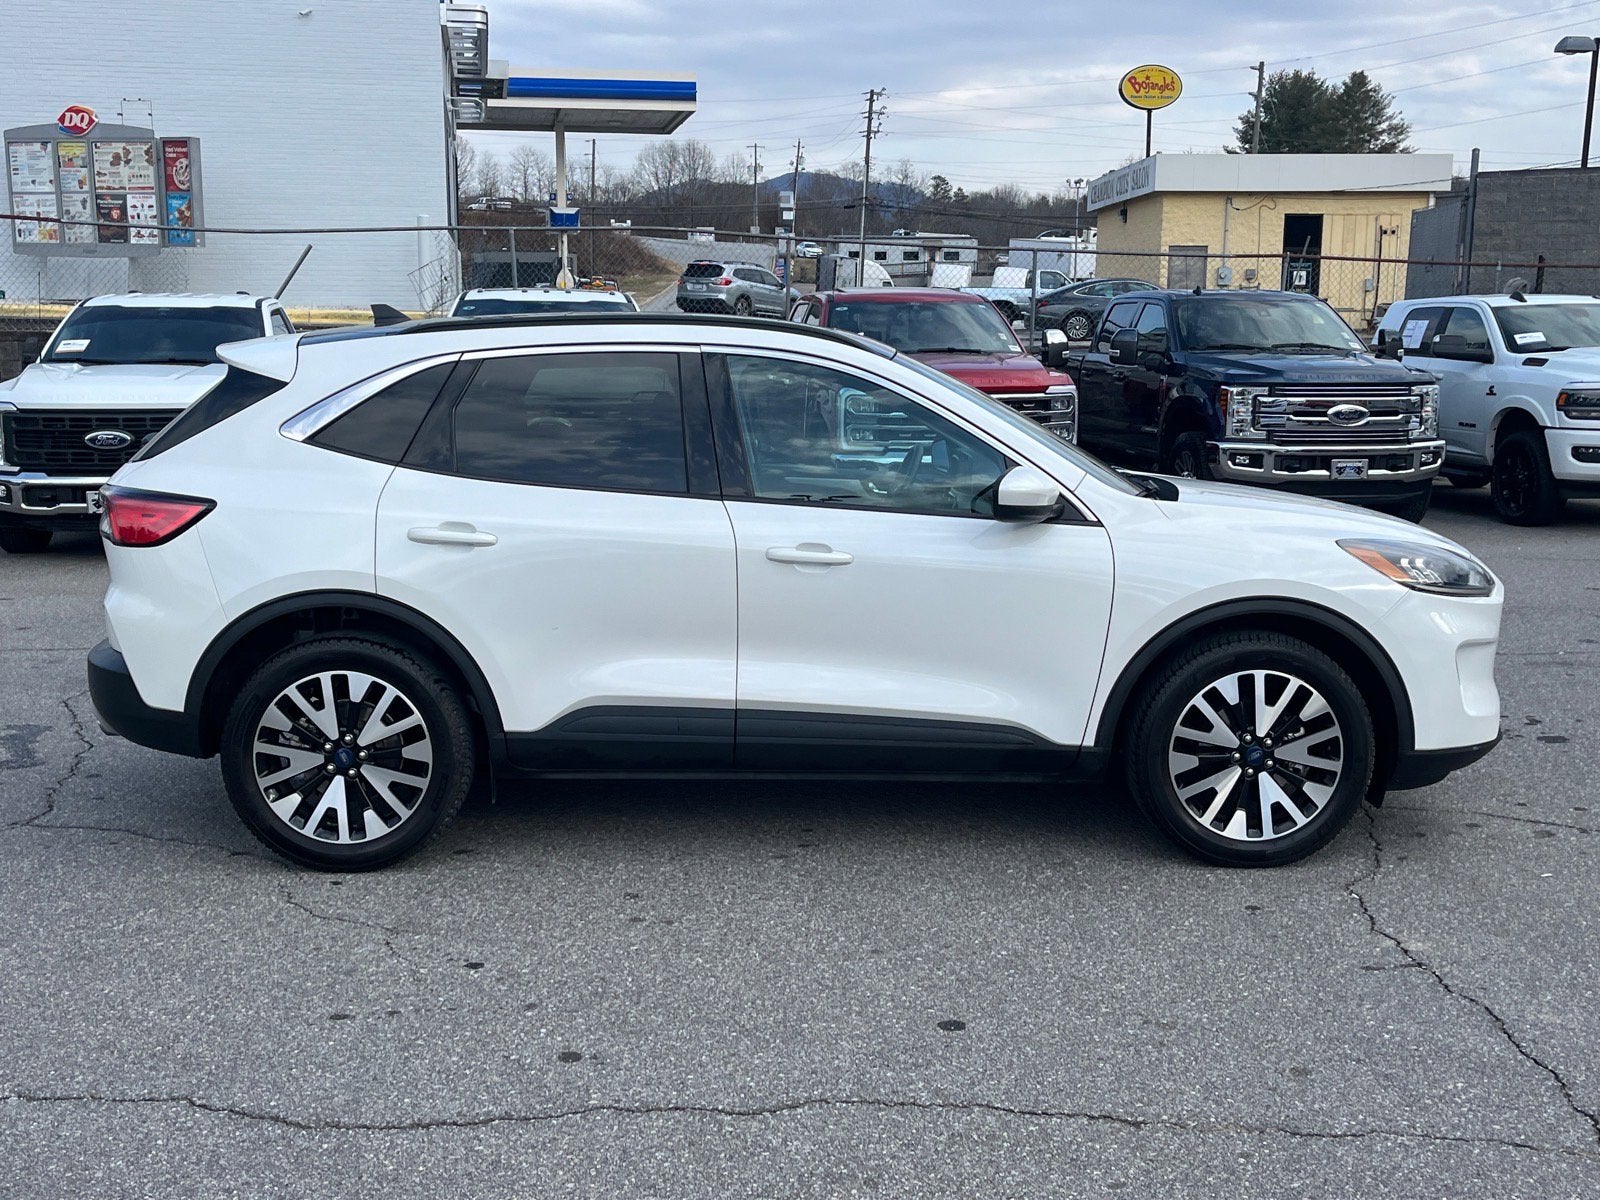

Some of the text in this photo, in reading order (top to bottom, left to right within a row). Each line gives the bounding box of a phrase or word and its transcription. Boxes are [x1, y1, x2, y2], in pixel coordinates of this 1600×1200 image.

[63, 111, 90, 129] DQ
[1131, 165, 1150, 190] SALON
[95, 434, 121, 446] Ford
